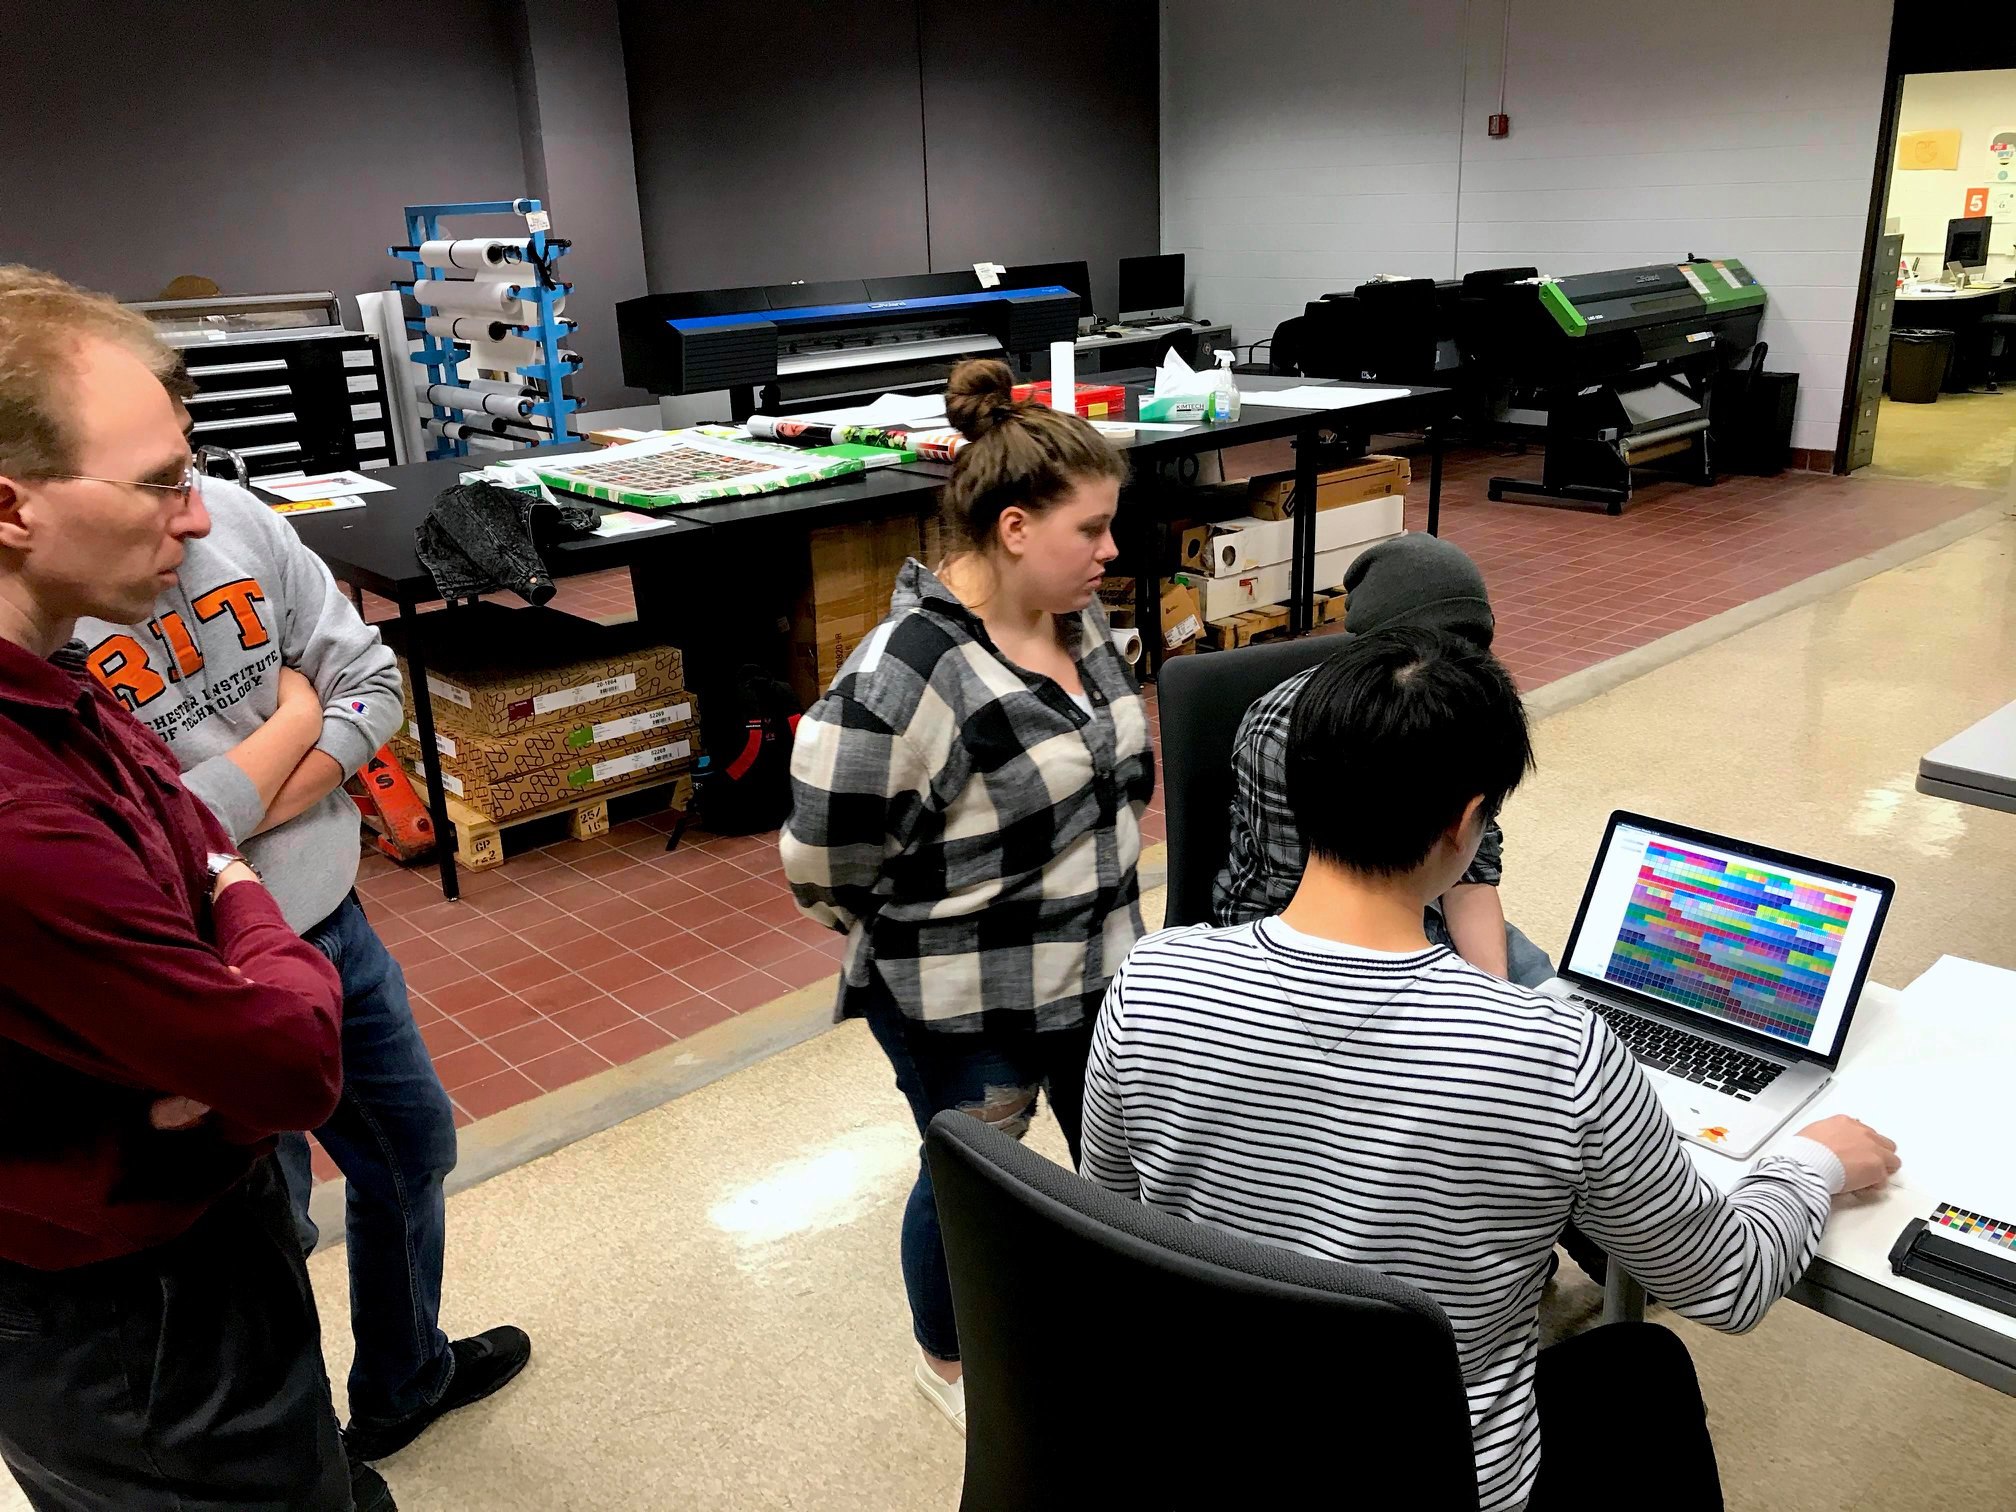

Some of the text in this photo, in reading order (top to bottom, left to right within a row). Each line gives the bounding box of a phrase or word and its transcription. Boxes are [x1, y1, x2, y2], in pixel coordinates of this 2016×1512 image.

[1969, 194, 1983, 212] 5
[86, 577, 270, 713] RIT
[203, 650, 279, 701] INSTITUTE
[184, 675, 263, 732] TECHNOLOGY
